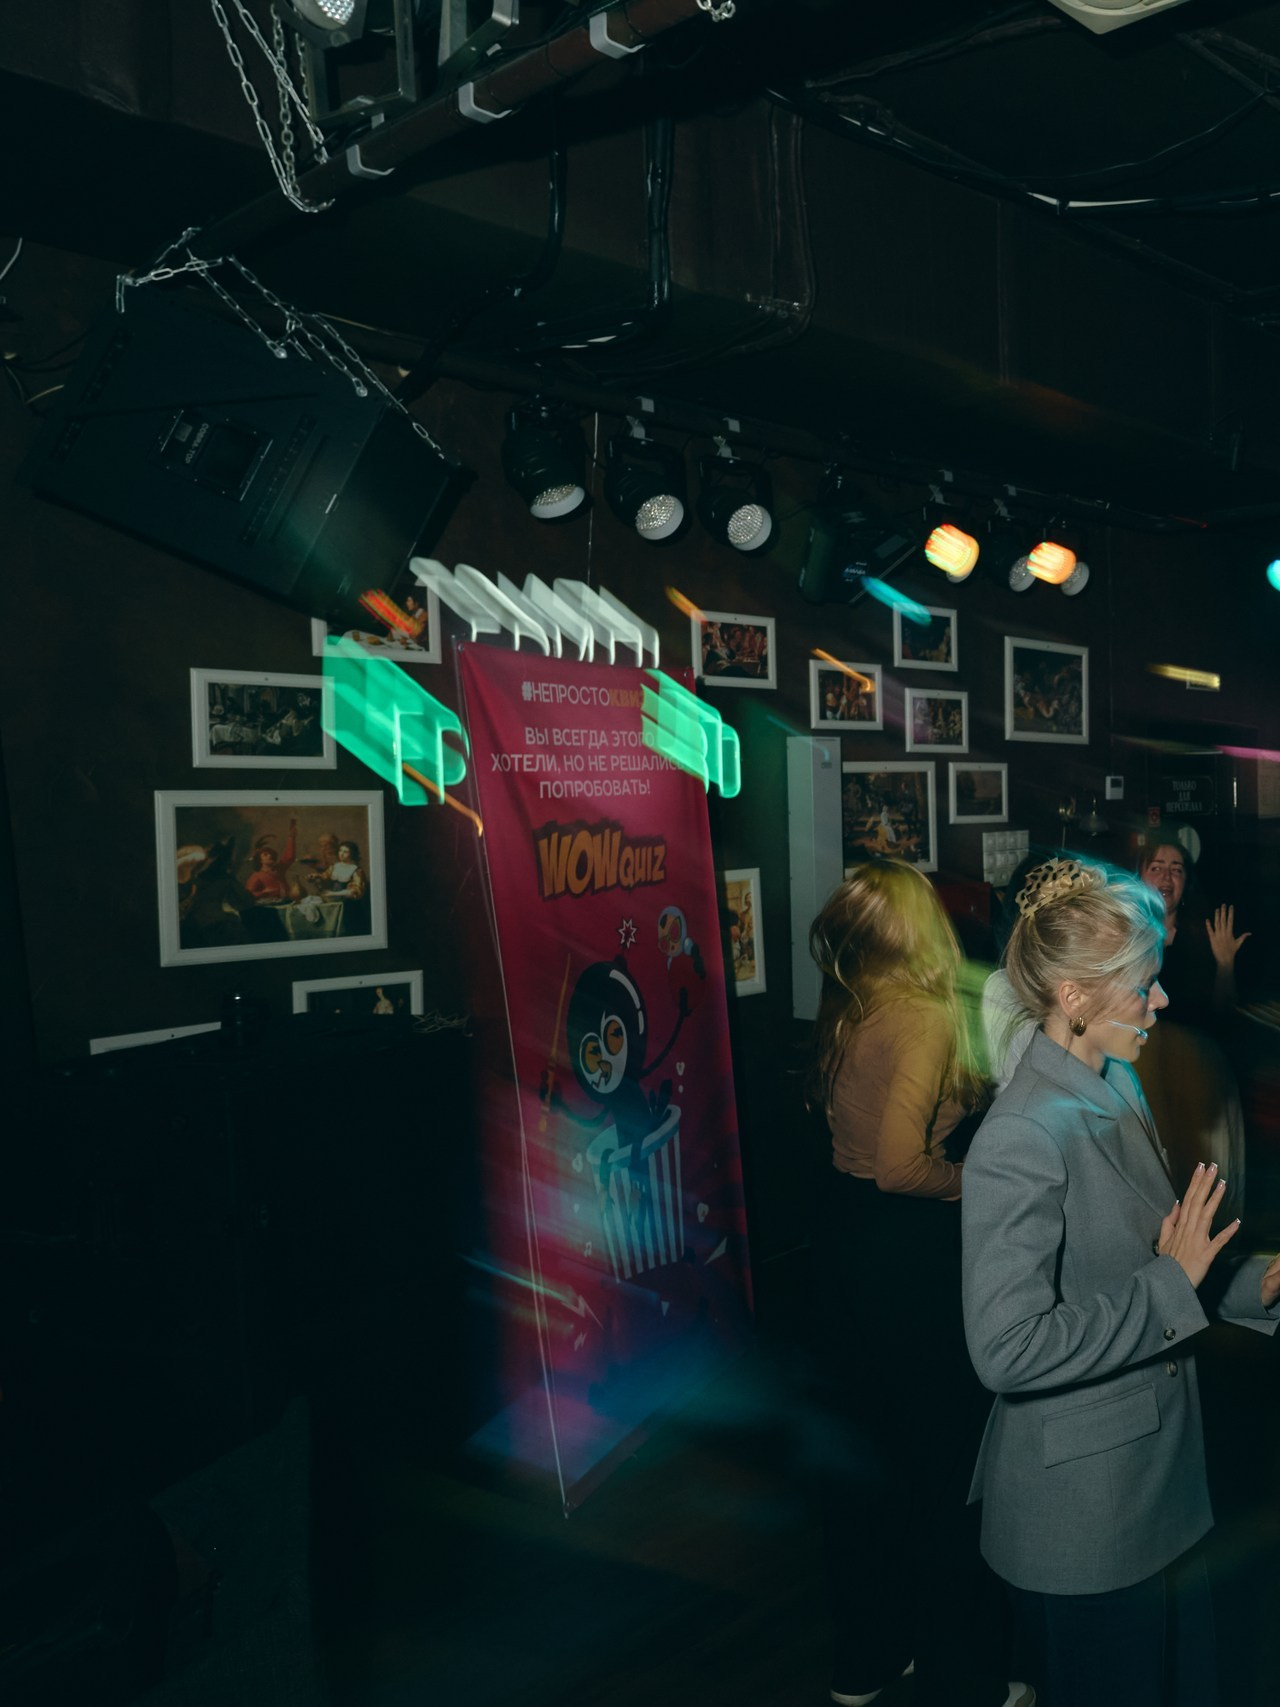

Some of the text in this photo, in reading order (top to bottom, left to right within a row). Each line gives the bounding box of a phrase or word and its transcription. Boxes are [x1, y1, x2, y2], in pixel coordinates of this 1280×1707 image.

[521, 681, 647, 708] #НЕПРОСТОКВИ
[525, 727, 655, 749] ВЫ ВСЕГДА ЭТОГО
[491, 753, 561, 774] ХОТЕЛИ,
[563, 755, 584, 772] НО
[588, 755, 607, 772] НЕ
[540, 779, 651, 799] ПОПРОБОВАТЬ!
